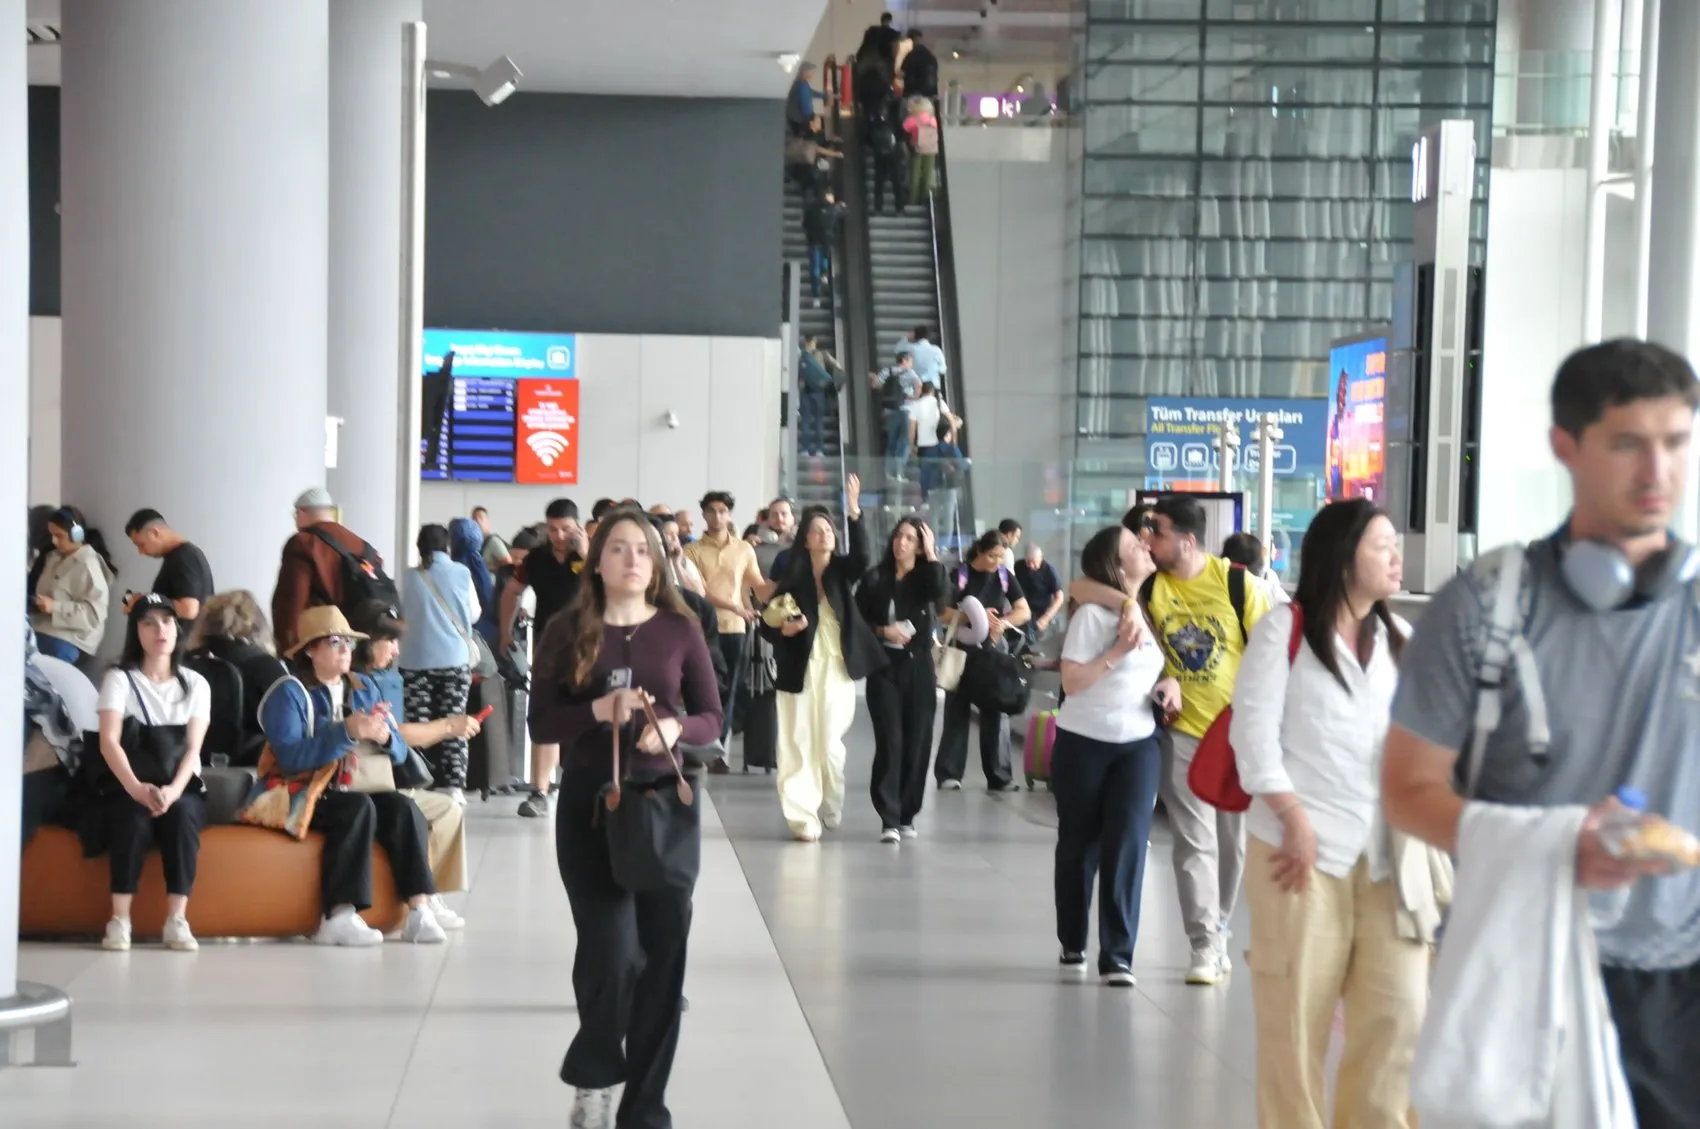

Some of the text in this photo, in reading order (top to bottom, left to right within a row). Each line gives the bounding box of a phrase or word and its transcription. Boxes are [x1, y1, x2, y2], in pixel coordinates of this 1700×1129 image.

[1151, 405, 1182, 421] Tüm
[1184, 406, 1243, 423] Transfer
[1152, 422, 1165, 433] All
[1166, 422, 1204, 434] Transfer
